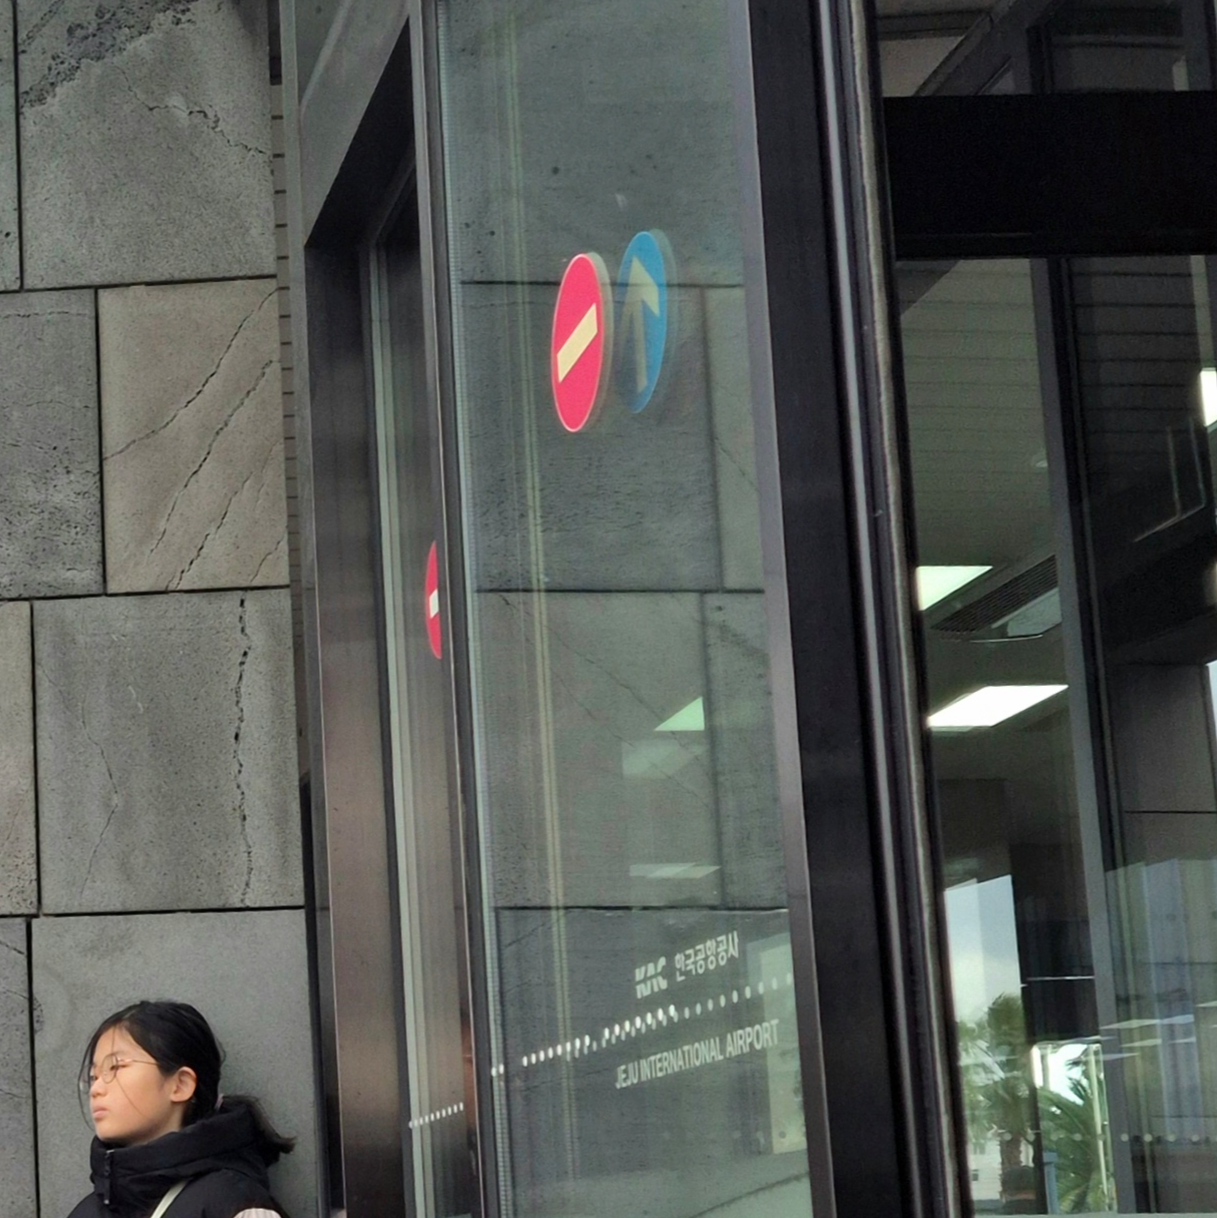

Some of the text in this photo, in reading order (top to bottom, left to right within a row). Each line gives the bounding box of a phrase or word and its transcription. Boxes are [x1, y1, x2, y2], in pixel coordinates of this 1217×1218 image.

[635, 930, 739, 999] KAC 한국공항공사
[615, 1018, 780, 1089] JEJU INTERNATIONAL AIRPORT
